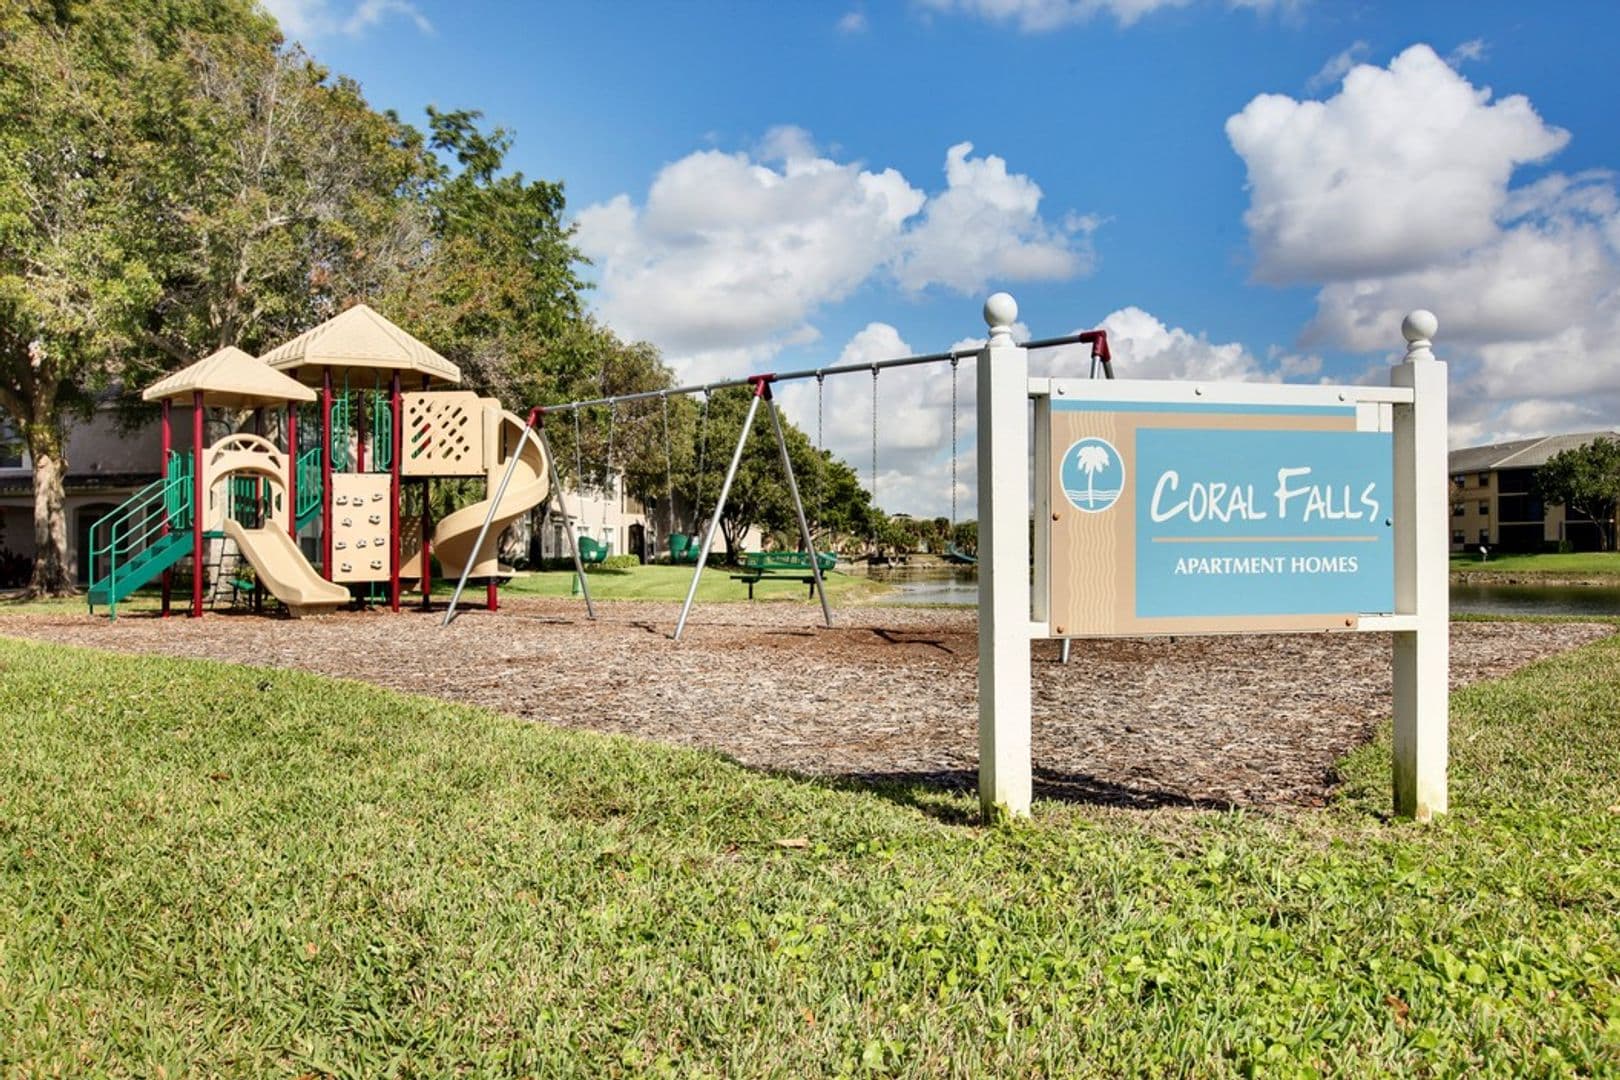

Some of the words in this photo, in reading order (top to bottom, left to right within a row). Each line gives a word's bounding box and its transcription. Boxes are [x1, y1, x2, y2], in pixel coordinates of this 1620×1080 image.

[1150, 470, 1267, 523] CORAL
[1274, 466, 1379, 522] FALLS
[1174, 557, 1285, 574] APARTMENT
[1291, 556, 1358, 573] HOMES
